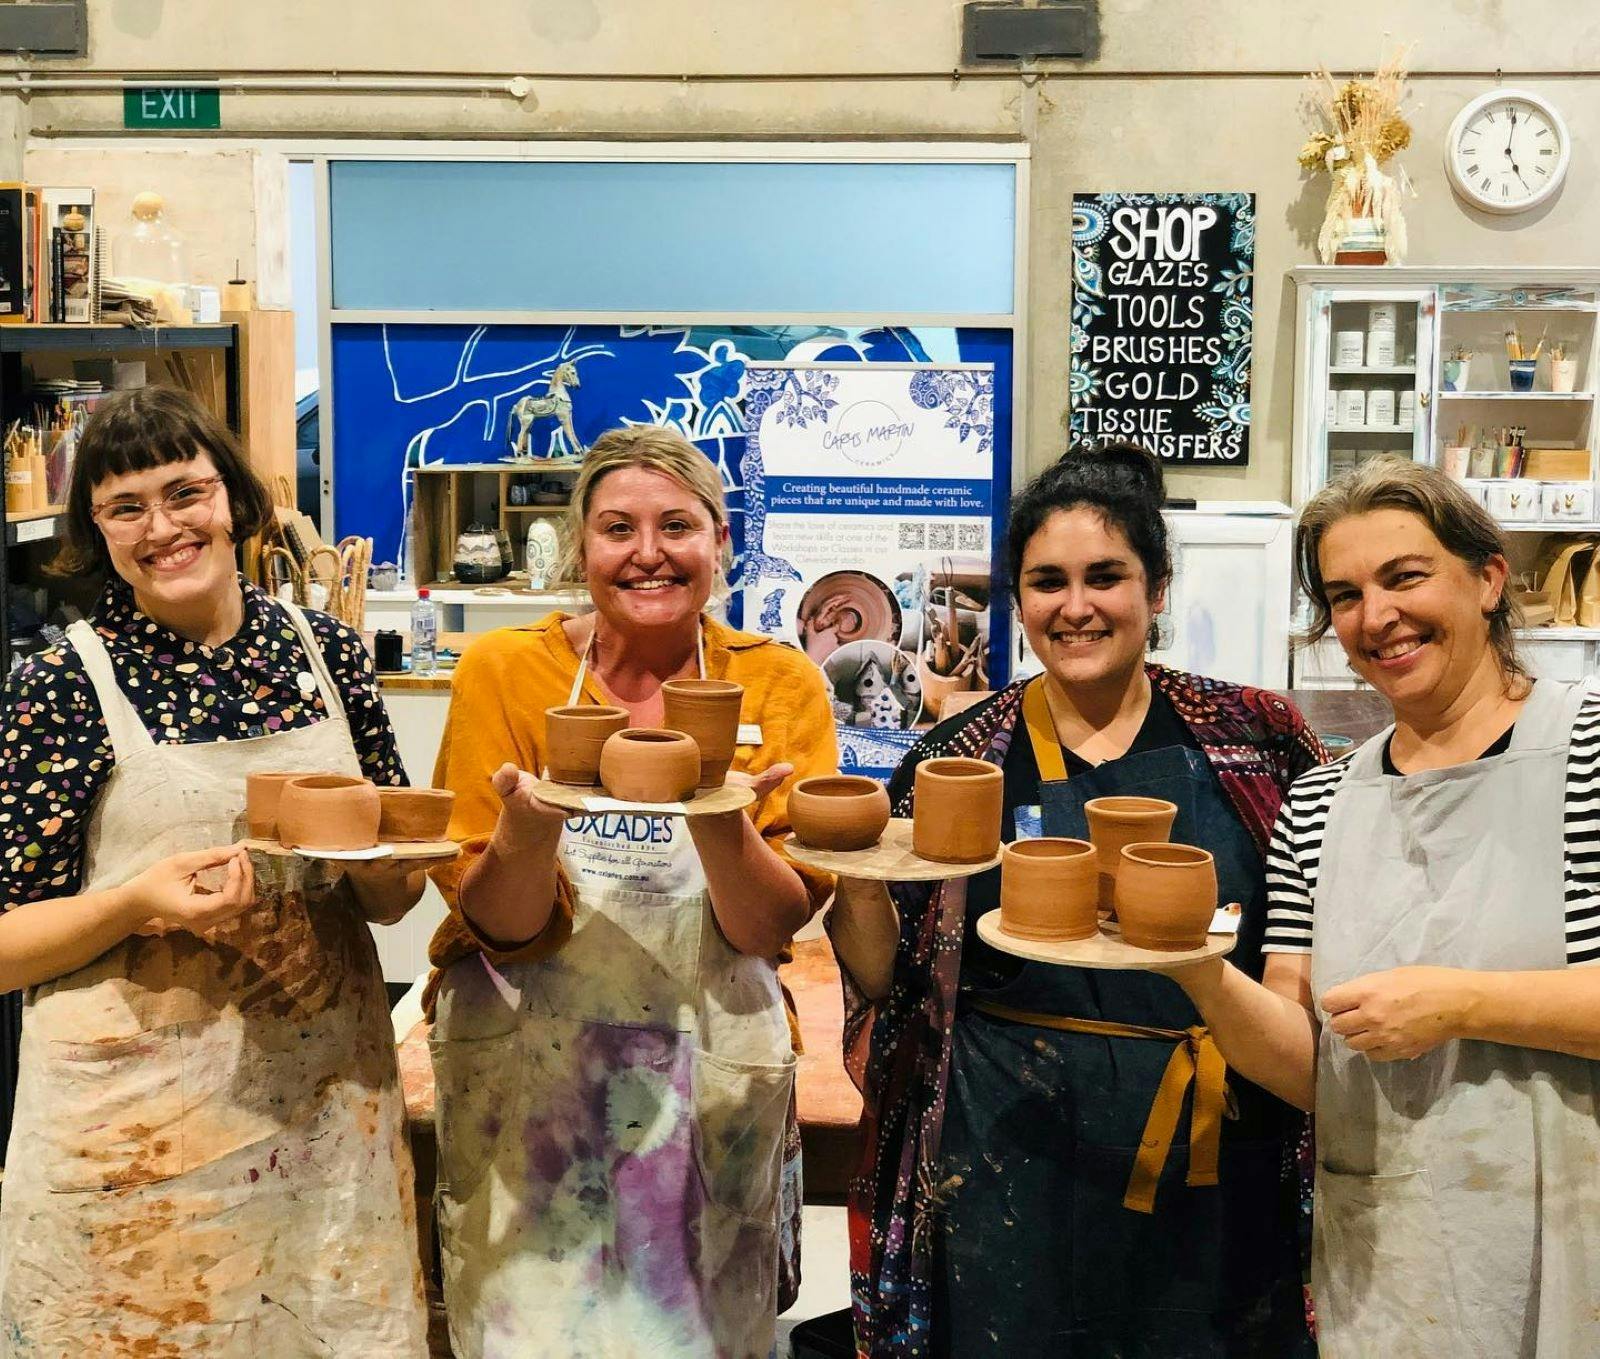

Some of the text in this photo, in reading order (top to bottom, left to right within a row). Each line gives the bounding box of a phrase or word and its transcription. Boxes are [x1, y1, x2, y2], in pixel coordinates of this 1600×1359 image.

[141, 88, 198, 119] EXIT
[1109, 206, 1217, 262] SHOP
[1108, 261, 1208, 287] GLAZES
[1109, 294, 1205, 328] TOOLS
[1092, 336, 1221, 366] BRUSHES
[1105, 371, 1199, 400] GOLD
[866, 422, 916, 443] MARTIN
[1075, 408, 1172, 434] TISSUE
[770, 494, 985, 509] pieces that are unique and made with love.
[782, 482, 972, 496] Creating beautiful handmade ceramic
[565, 813, 673, 843] OXLADES
